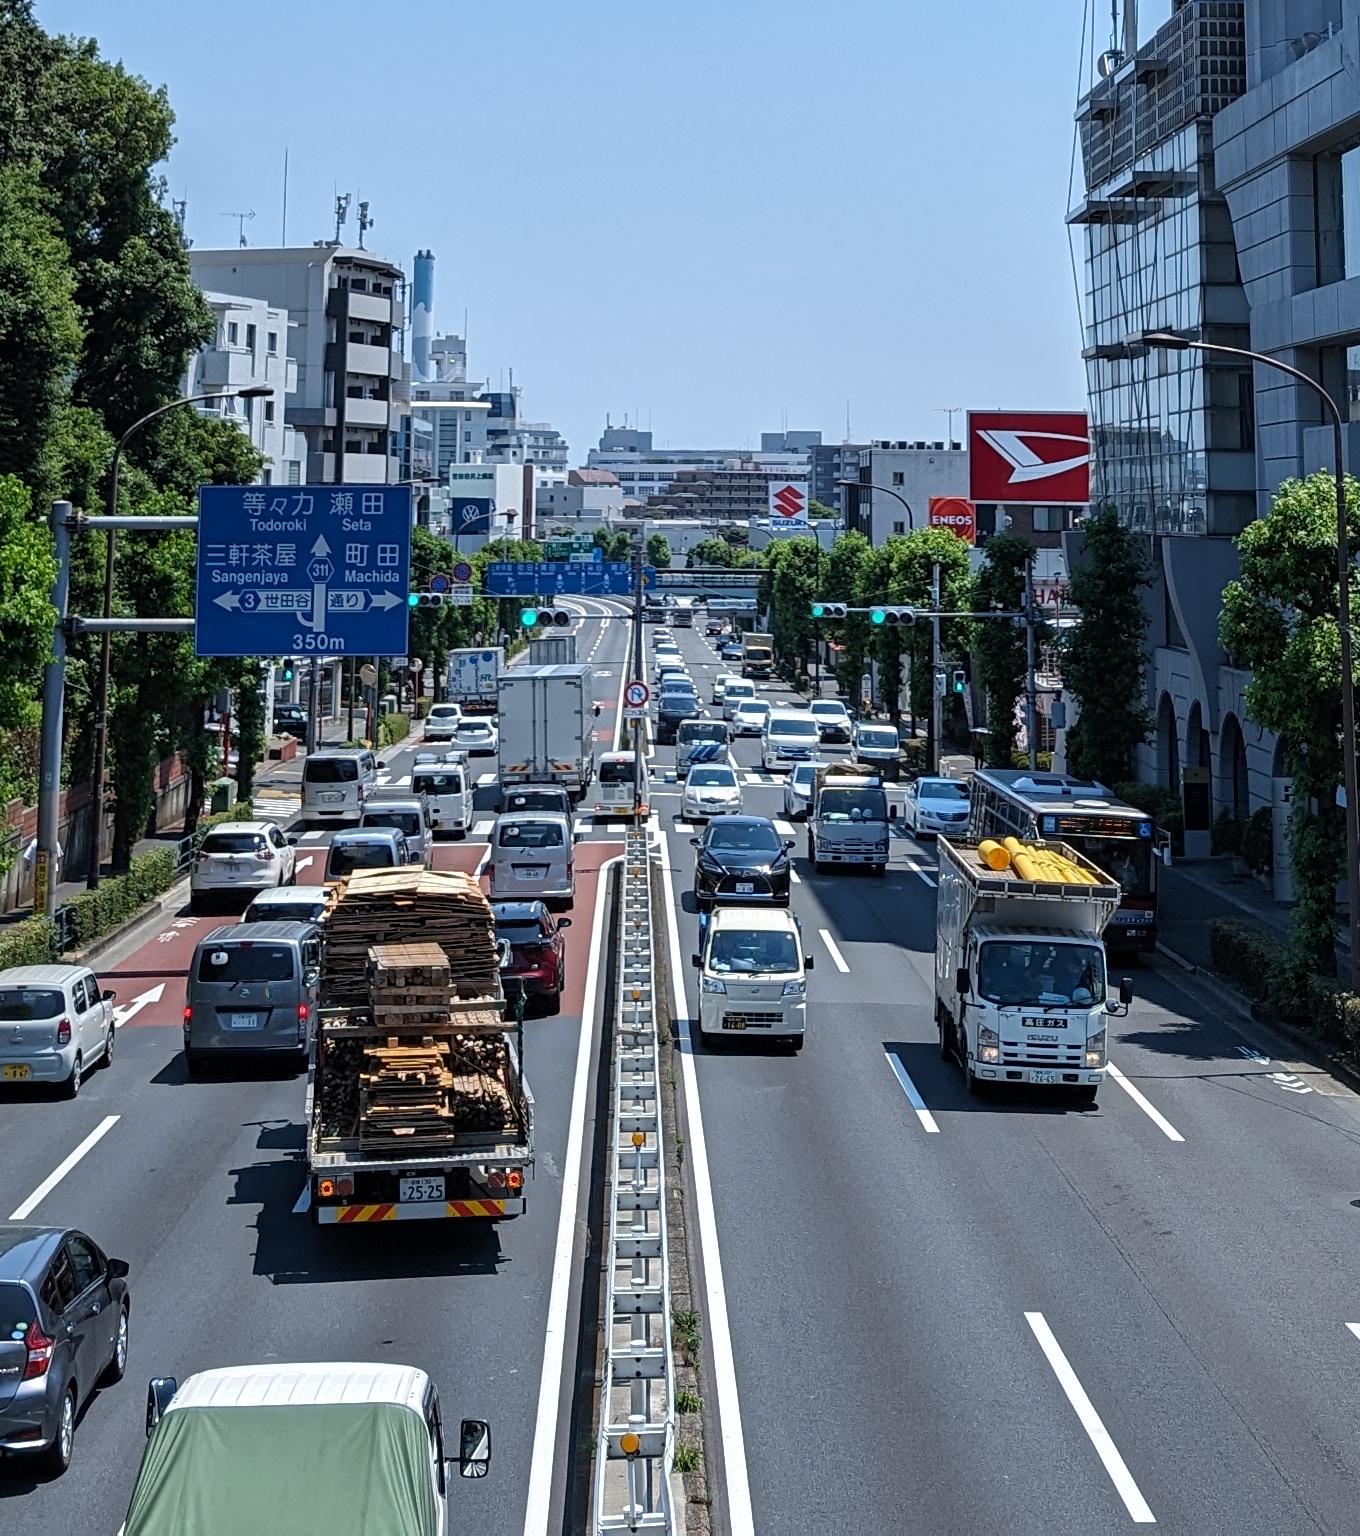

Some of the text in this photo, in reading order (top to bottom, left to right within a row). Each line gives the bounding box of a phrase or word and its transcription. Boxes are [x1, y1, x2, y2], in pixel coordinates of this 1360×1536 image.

[243, 492, 384, 515] 等々力 瀬田
[250, 519, 372, 531] Todoroki Seta
[772, 519, 806, 527] SUZUKI
[932, 515, 972, 525] ENEOS
[205, 543, 400, 567] 三軒茶屋 町田
[312, 564, 329, 576] 311
[211, 570, 400, 585] Sangenjaya Machida
[244, 594, 256, 607] 3
[265, 594, 359, 608] 世田谷 通り
[292, 634, 345, 650] 350m
[1025, 1018, 1065, 1027] 高圧ガス
[1027, 1034, 1059, 1042] ISUZU
[407, 1185, 443, 1200] 25-25
